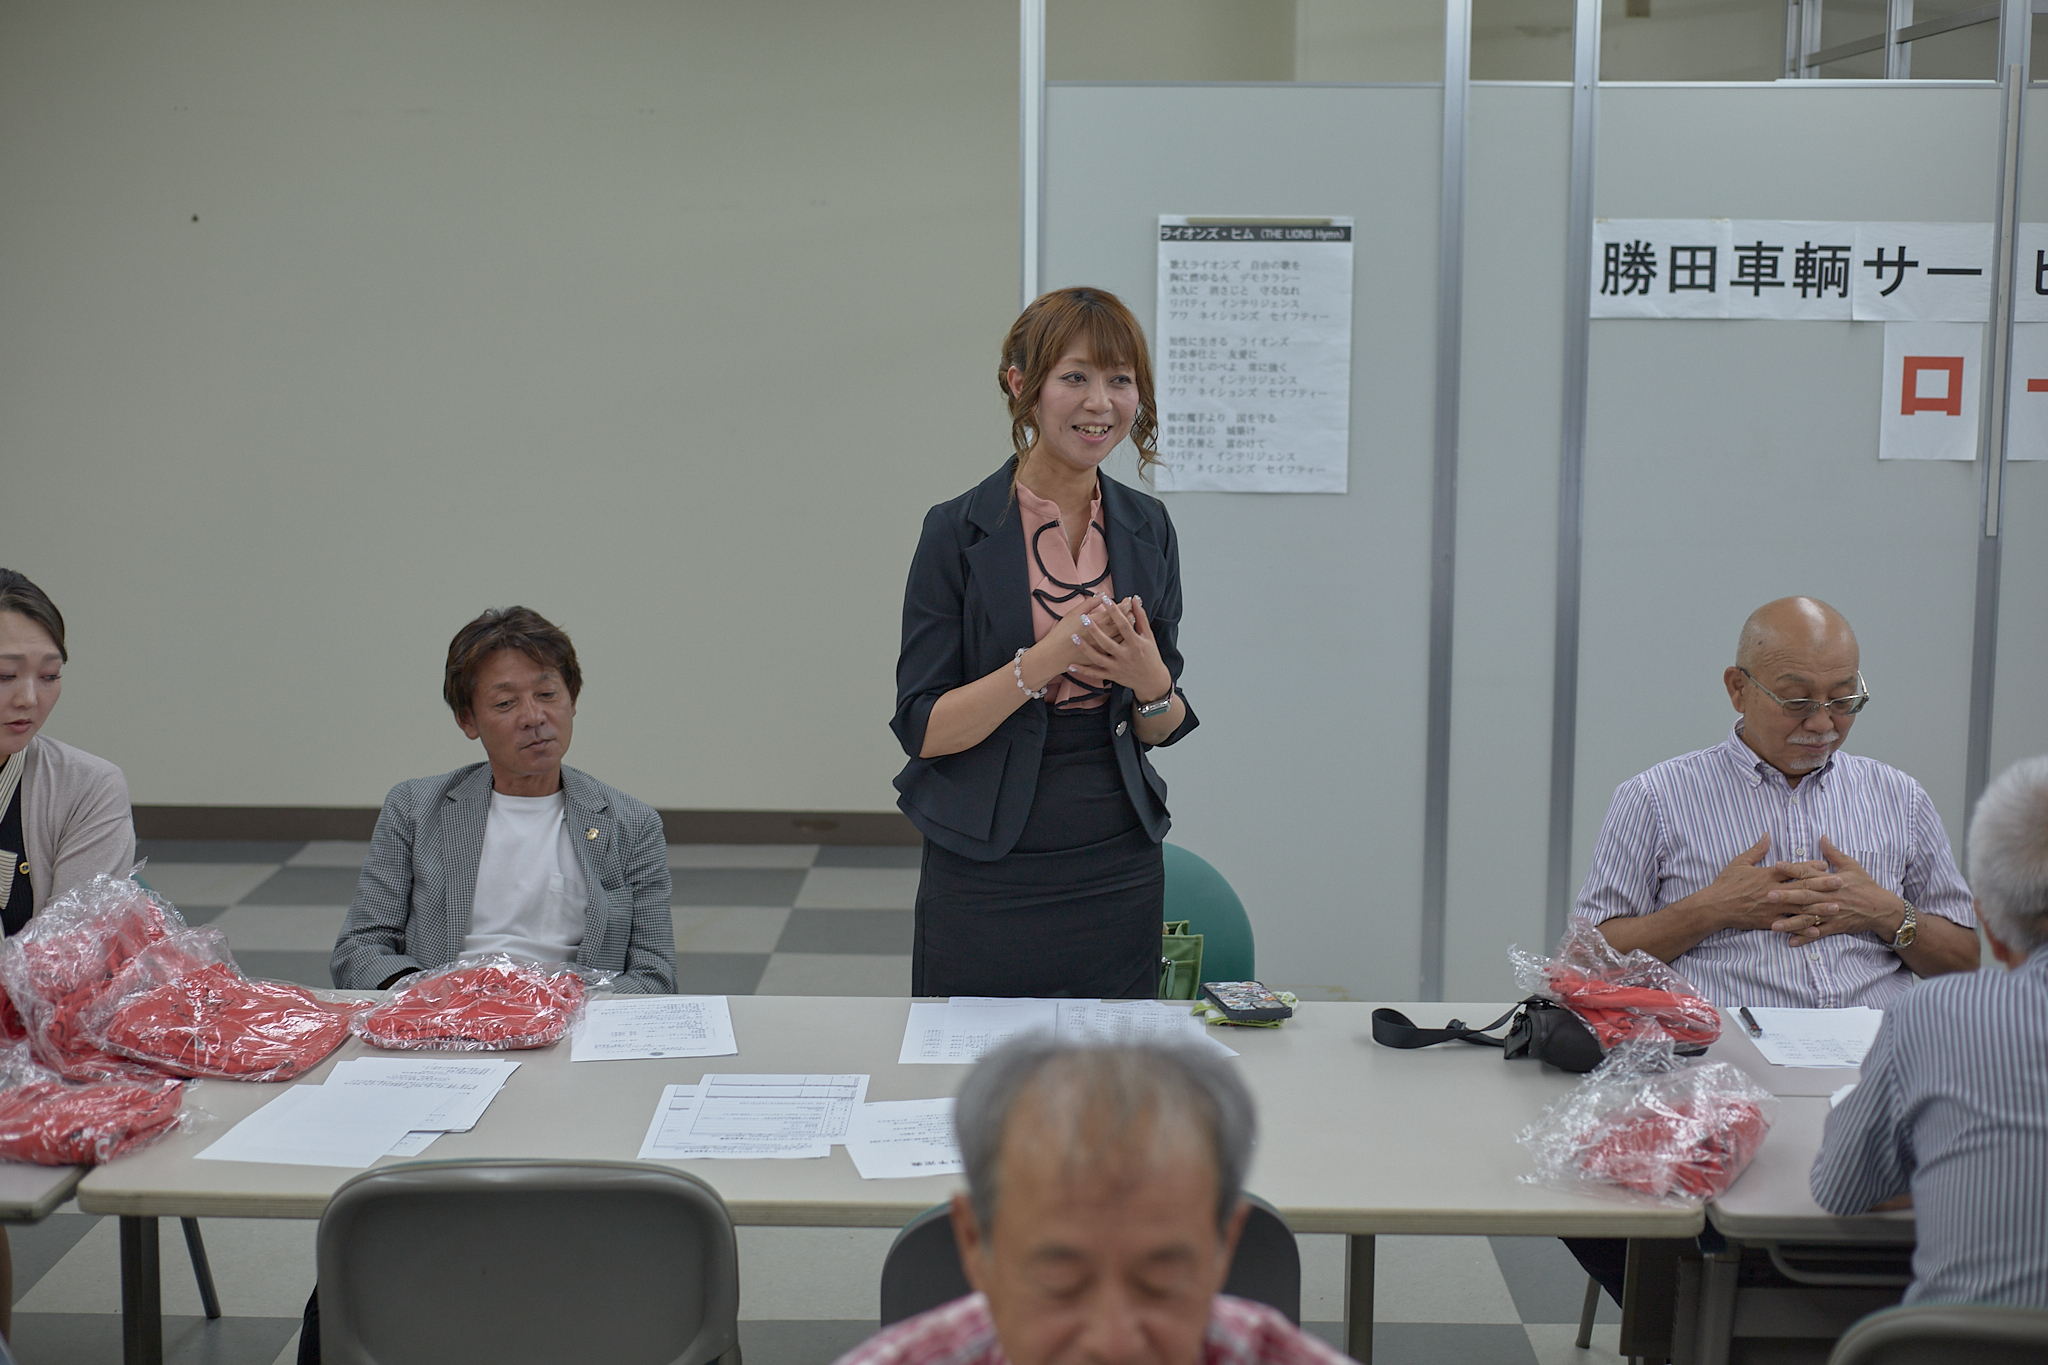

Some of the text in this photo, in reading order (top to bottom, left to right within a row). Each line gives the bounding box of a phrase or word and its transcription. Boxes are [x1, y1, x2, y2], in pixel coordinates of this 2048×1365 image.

[1162, 227, 1255, 240] ライオンズ・ヒム
[1599, 239, 2048, 299] 勝田車輌サー
[1240, 274, 1300, 283] デモクラシー
[1220, 299, 1300, 308] インテリジェンス
[1199, 311, 1259, 321] ネイションズ
[1239, 336, 1289, 347] ライオンズ
[1218, 376, 1298, 385] インテリジェンス
[1198, 388, 1258, 397] ネイションズ
[1217, 452, 1296, 461] インテリジェンス
[1196, 464, 1256, 474] ネイションズ
